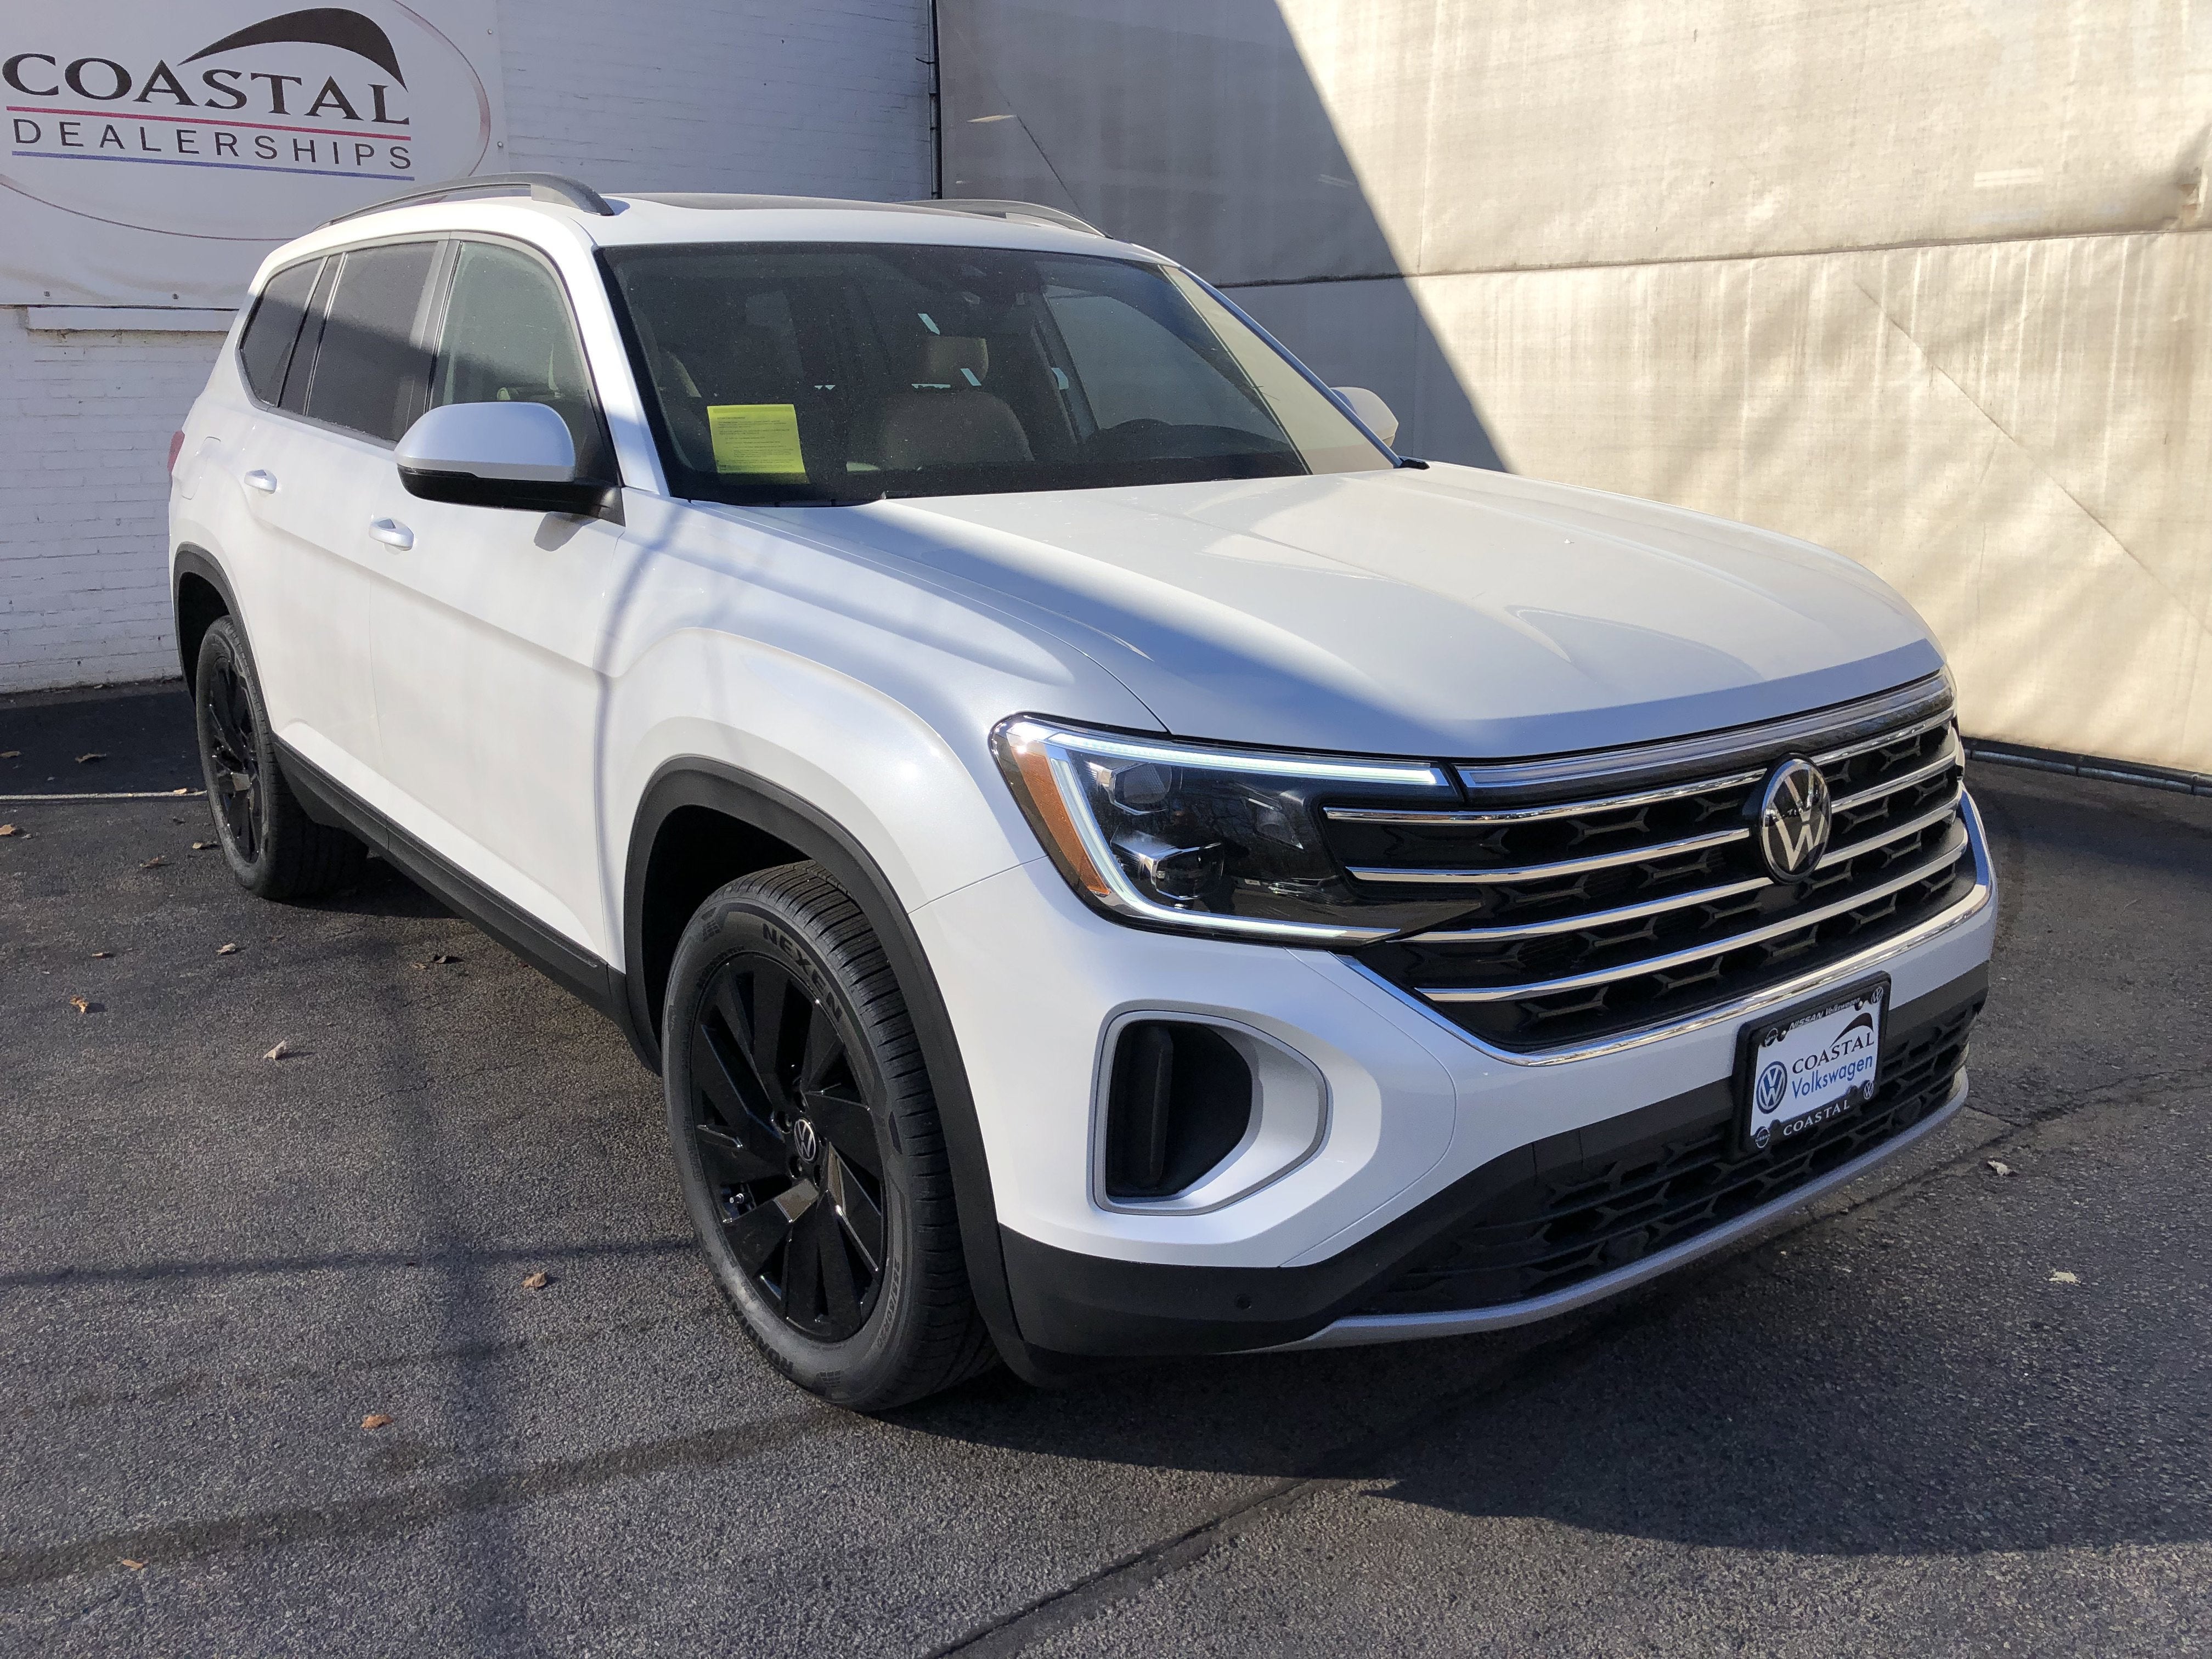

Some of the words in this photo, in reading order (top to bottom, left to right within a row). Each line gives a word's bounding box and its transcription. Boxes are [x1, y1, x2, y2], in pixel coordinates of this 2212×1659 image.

[2, 53, 410, 126] COASTAL
[13, 118, 412, 170] DEALERSHIPS
[763, 923, 843, 1022] NEXEN
[1789, 1011, 1824, 1031] NISSAN
[1792, 1031, 1875, 1074] COASTAL
[1791, 1056, 1873, 1099] Volkswagen
[1783, 1099, 1850, 1136] COASTAL
